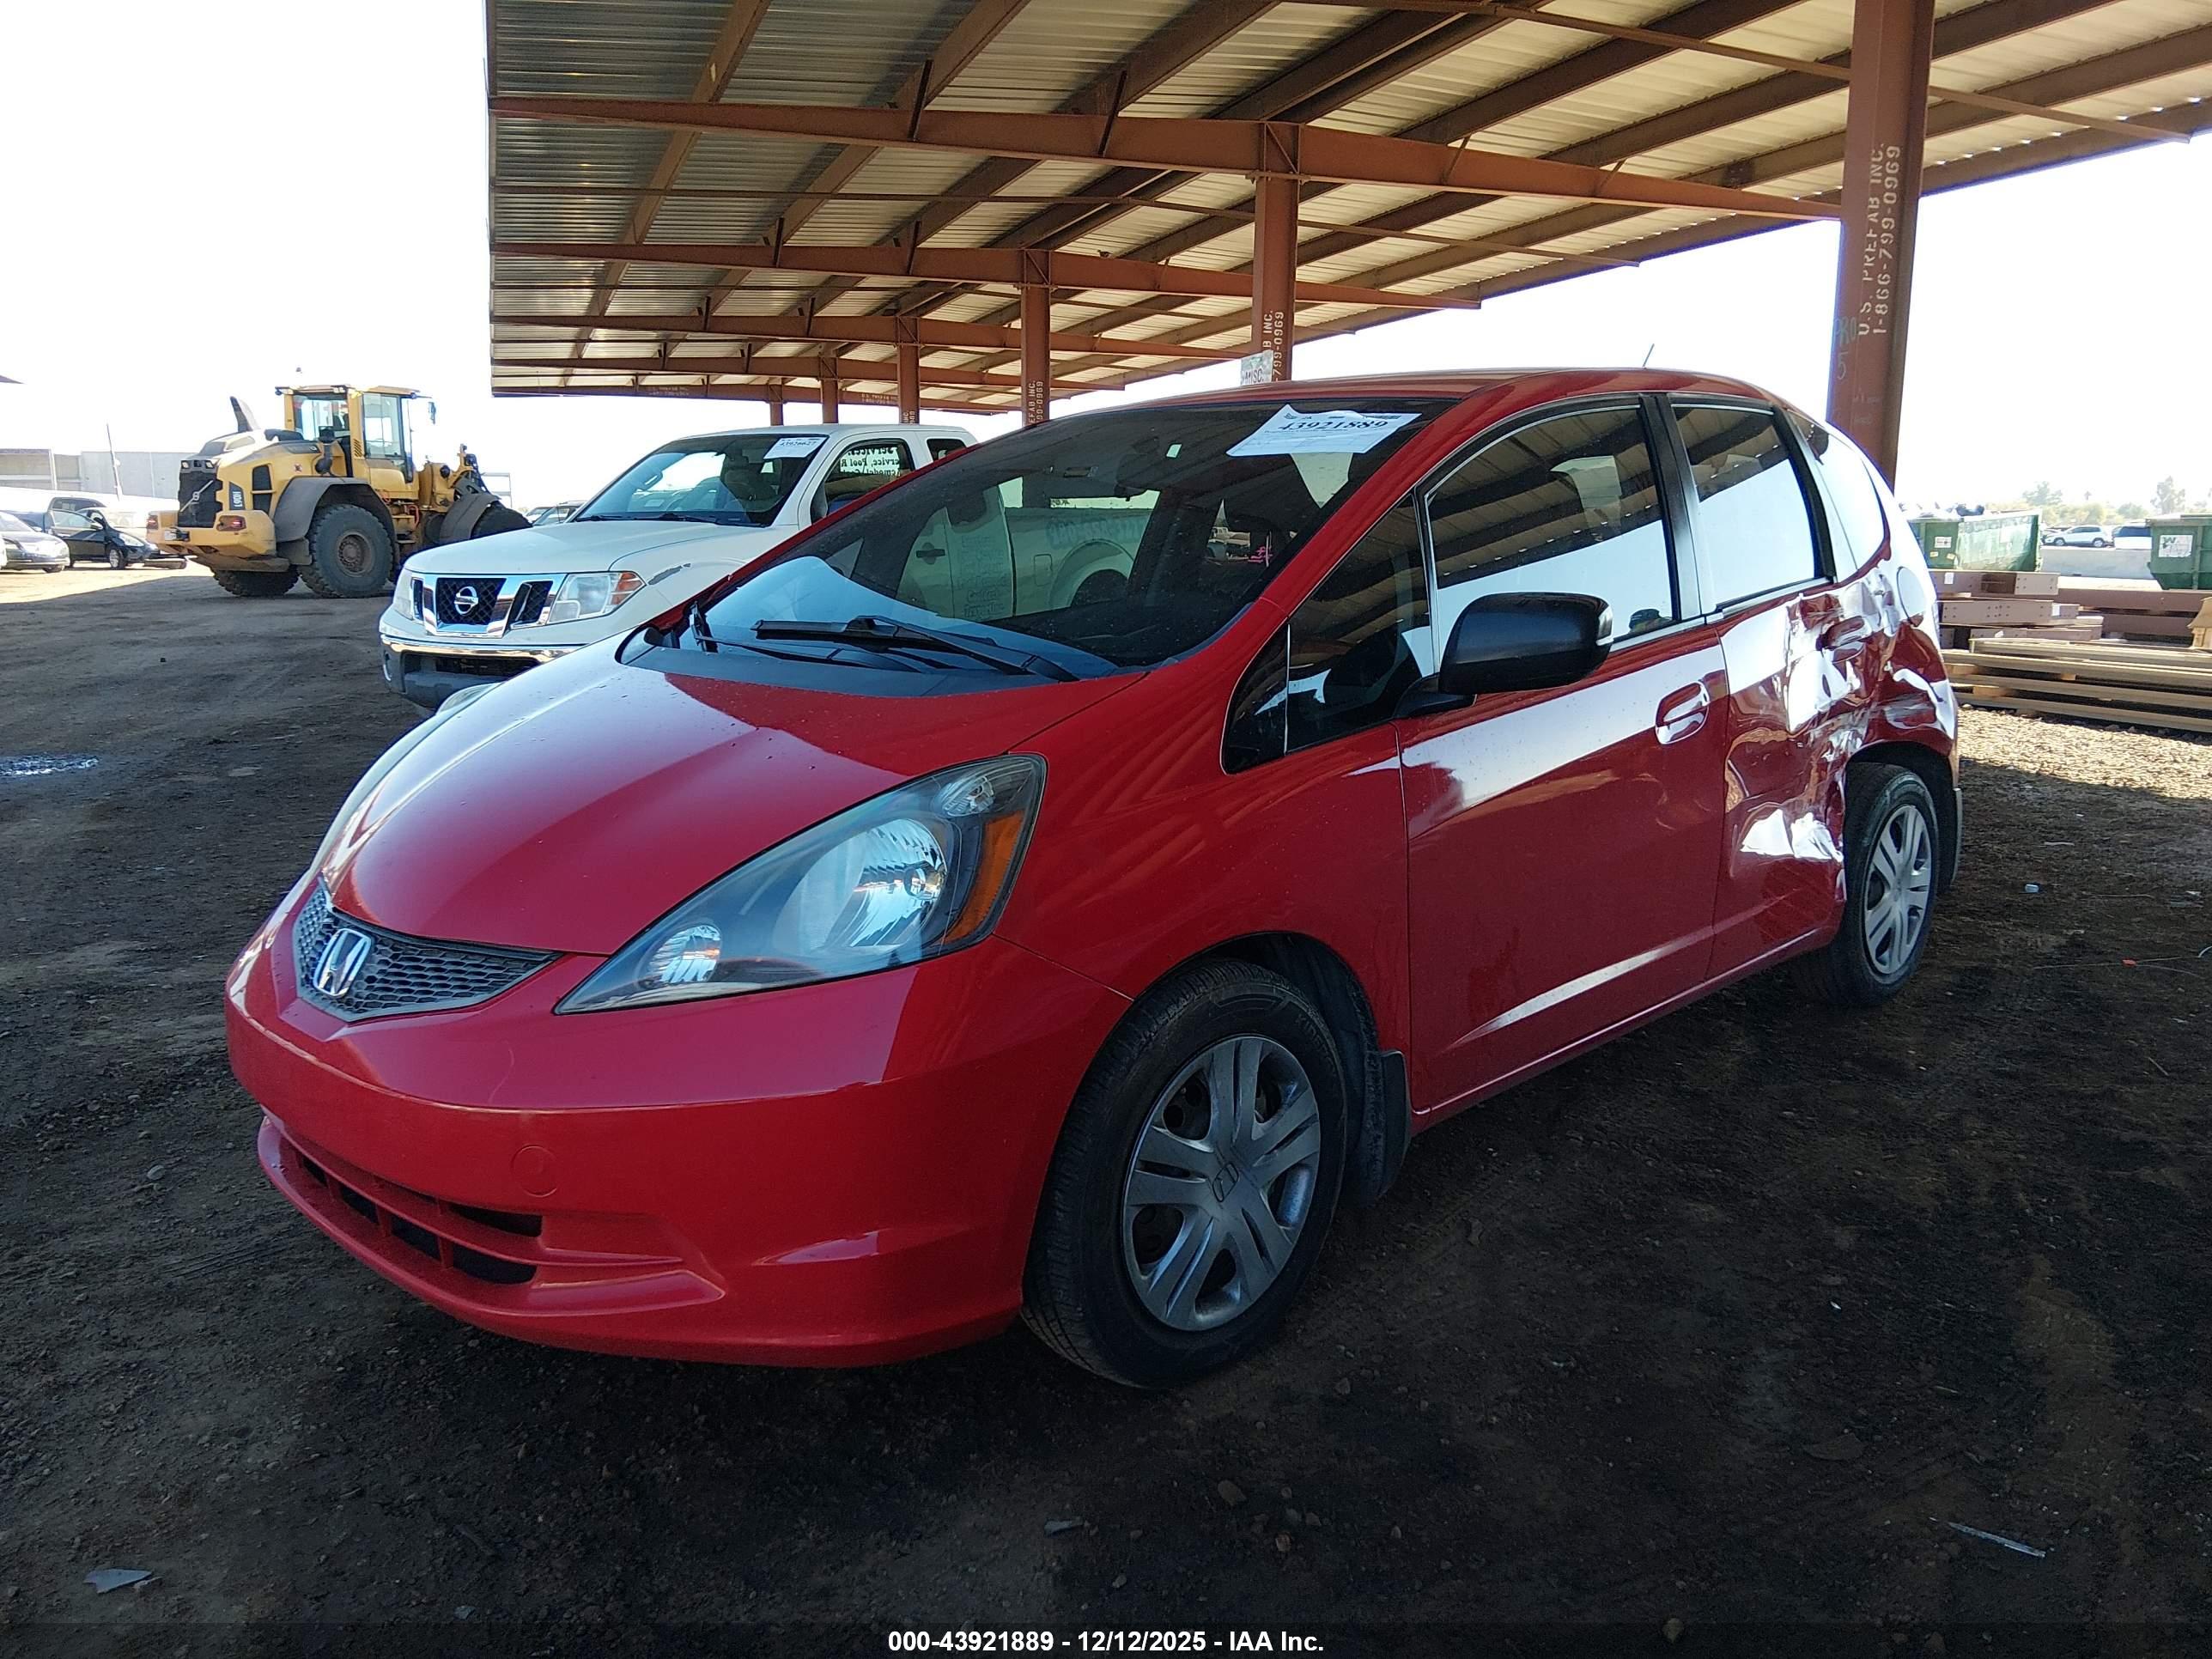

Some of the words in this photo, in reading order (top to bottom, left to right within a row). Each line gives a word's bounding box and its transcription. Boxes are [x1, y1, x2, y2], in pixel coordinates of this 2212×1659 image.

[1869, 143, 1884, 184] INC.
[1873, 145, 1900, 334] 1-866-799-0969
[1262, 310, 1273, 334] INC.
[1277, 420, 1389, 430] 43921889
